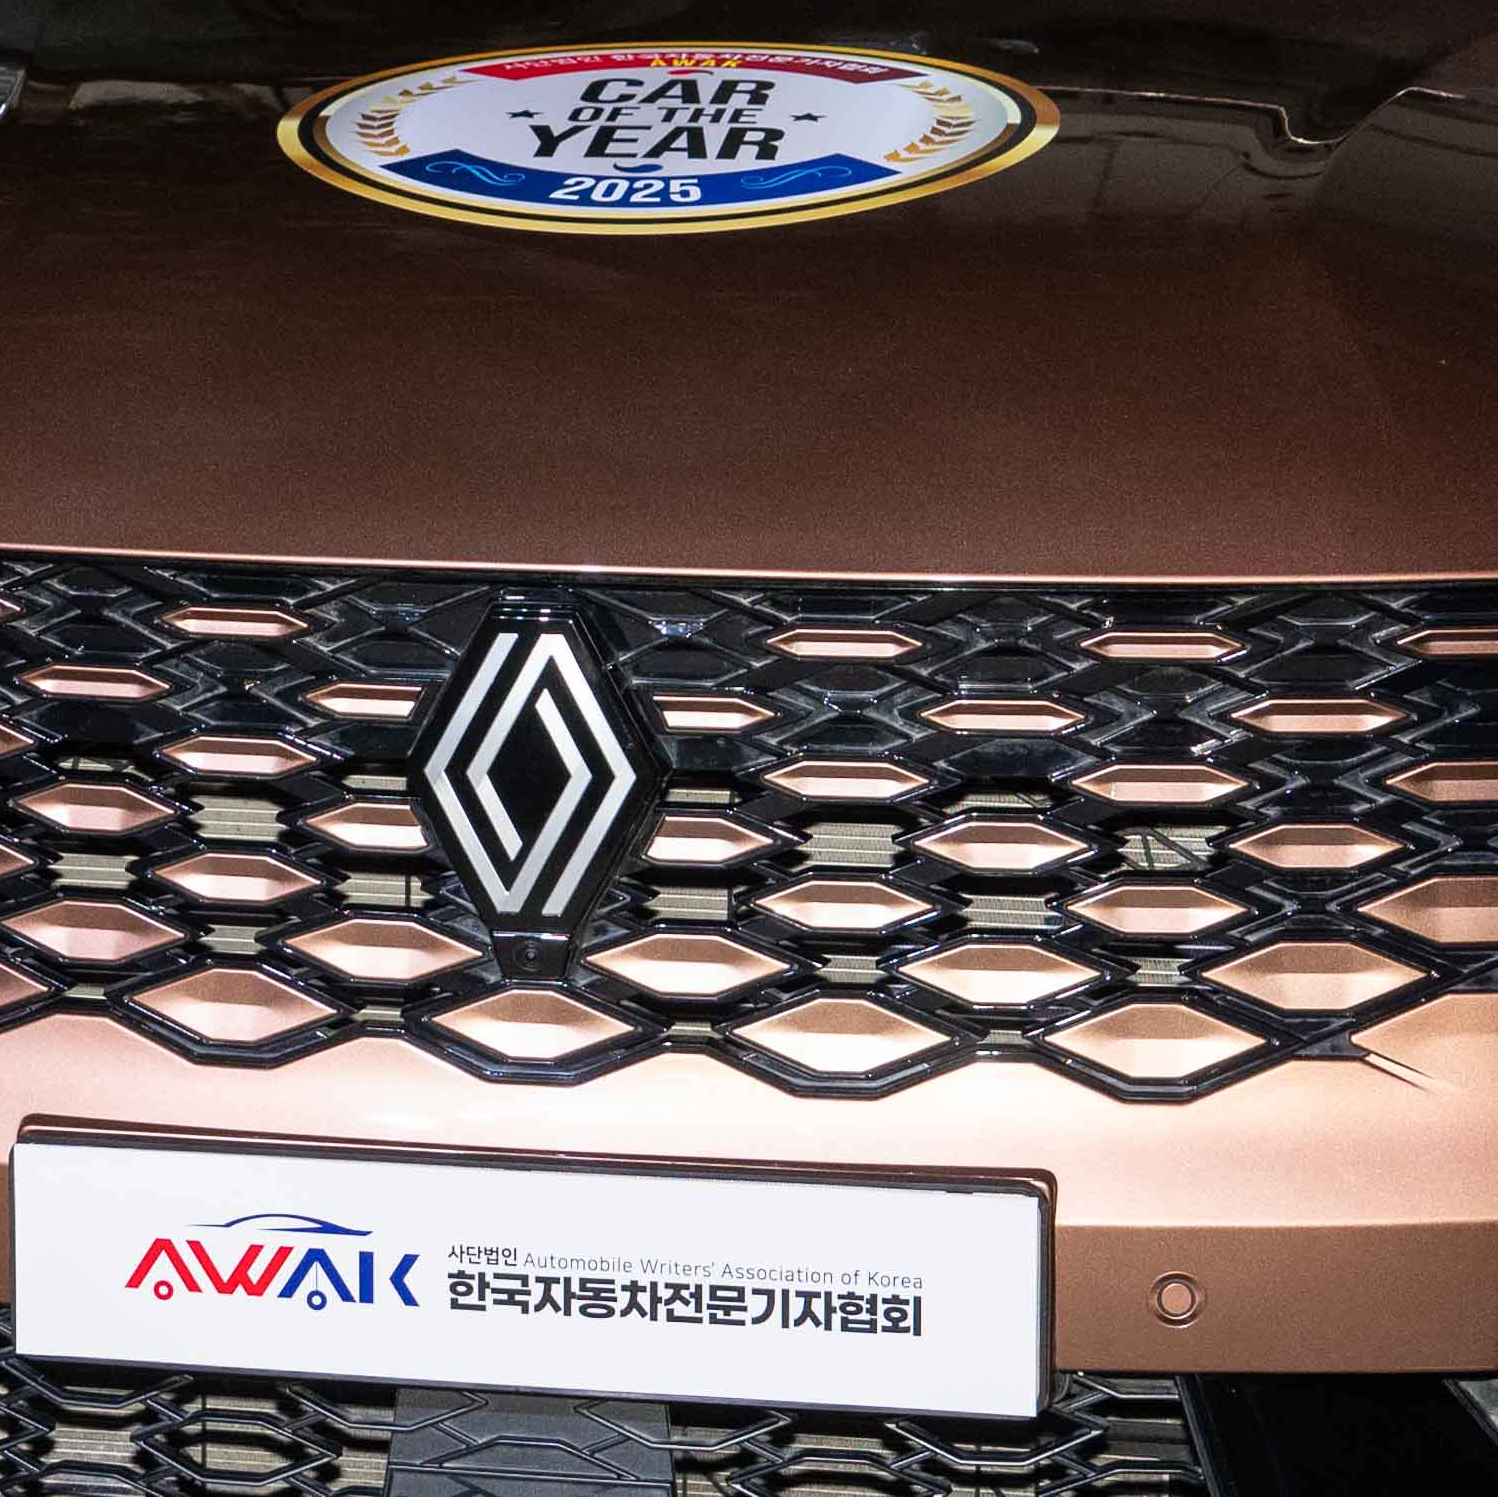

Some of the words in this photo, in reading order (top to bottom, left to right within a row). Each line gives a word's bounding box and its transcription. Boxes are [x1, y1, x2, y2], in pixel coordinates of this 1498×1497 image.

[651, 58, 742, 67] AWAK
[579, 78, 776, 105] CAR
[567, 106, 641, 122] OF
[656, 107, 764, 124] THE
[528, 124, 786, 161] YEAR
[548, 176, 702, 202] 2025
[124, 1237, 420, 1310] AWAK
[447, 1244, 518, 1267] 사단법인
[523, 1252, 633, 1273] Automobile
[640, 1258, 715, 1278] Writers'
[721, 1262, 833, 1285] Association
[840, 1269, 860, 1286] of
[867, 1271, 923, 1289] Korea
[447, 1269, 922, 1336] 한국자동차전문기자협회
